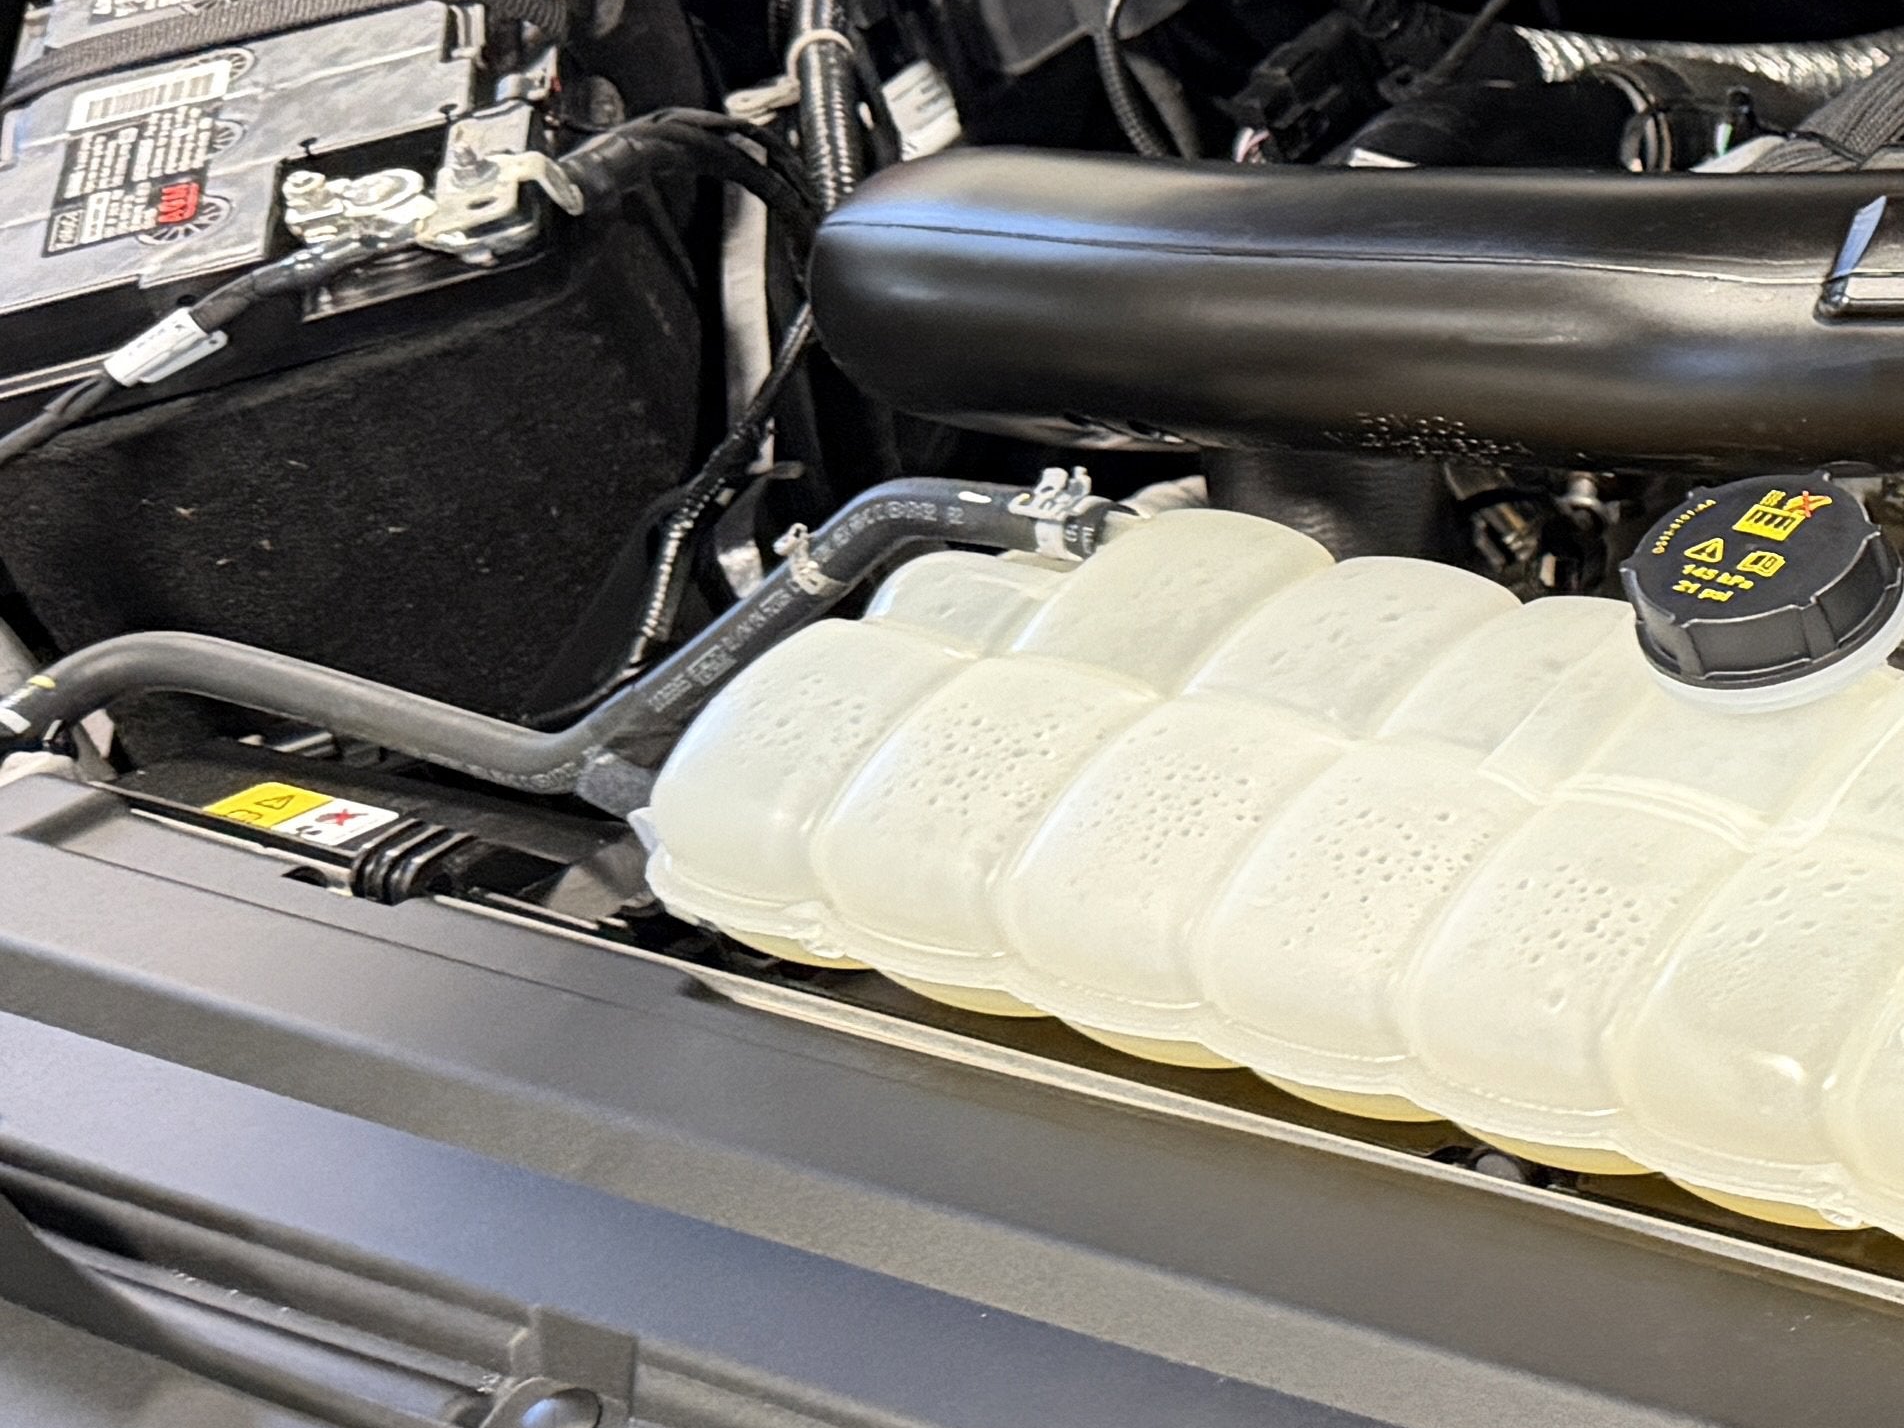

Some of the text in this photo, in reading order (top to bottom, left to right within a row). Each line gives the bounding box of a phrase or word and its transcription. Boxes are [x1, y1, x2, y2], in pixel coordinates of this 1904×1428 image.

[1671, 579, 1702, 595] 21
[1681, 563, 1755, 590] 145 kPa
